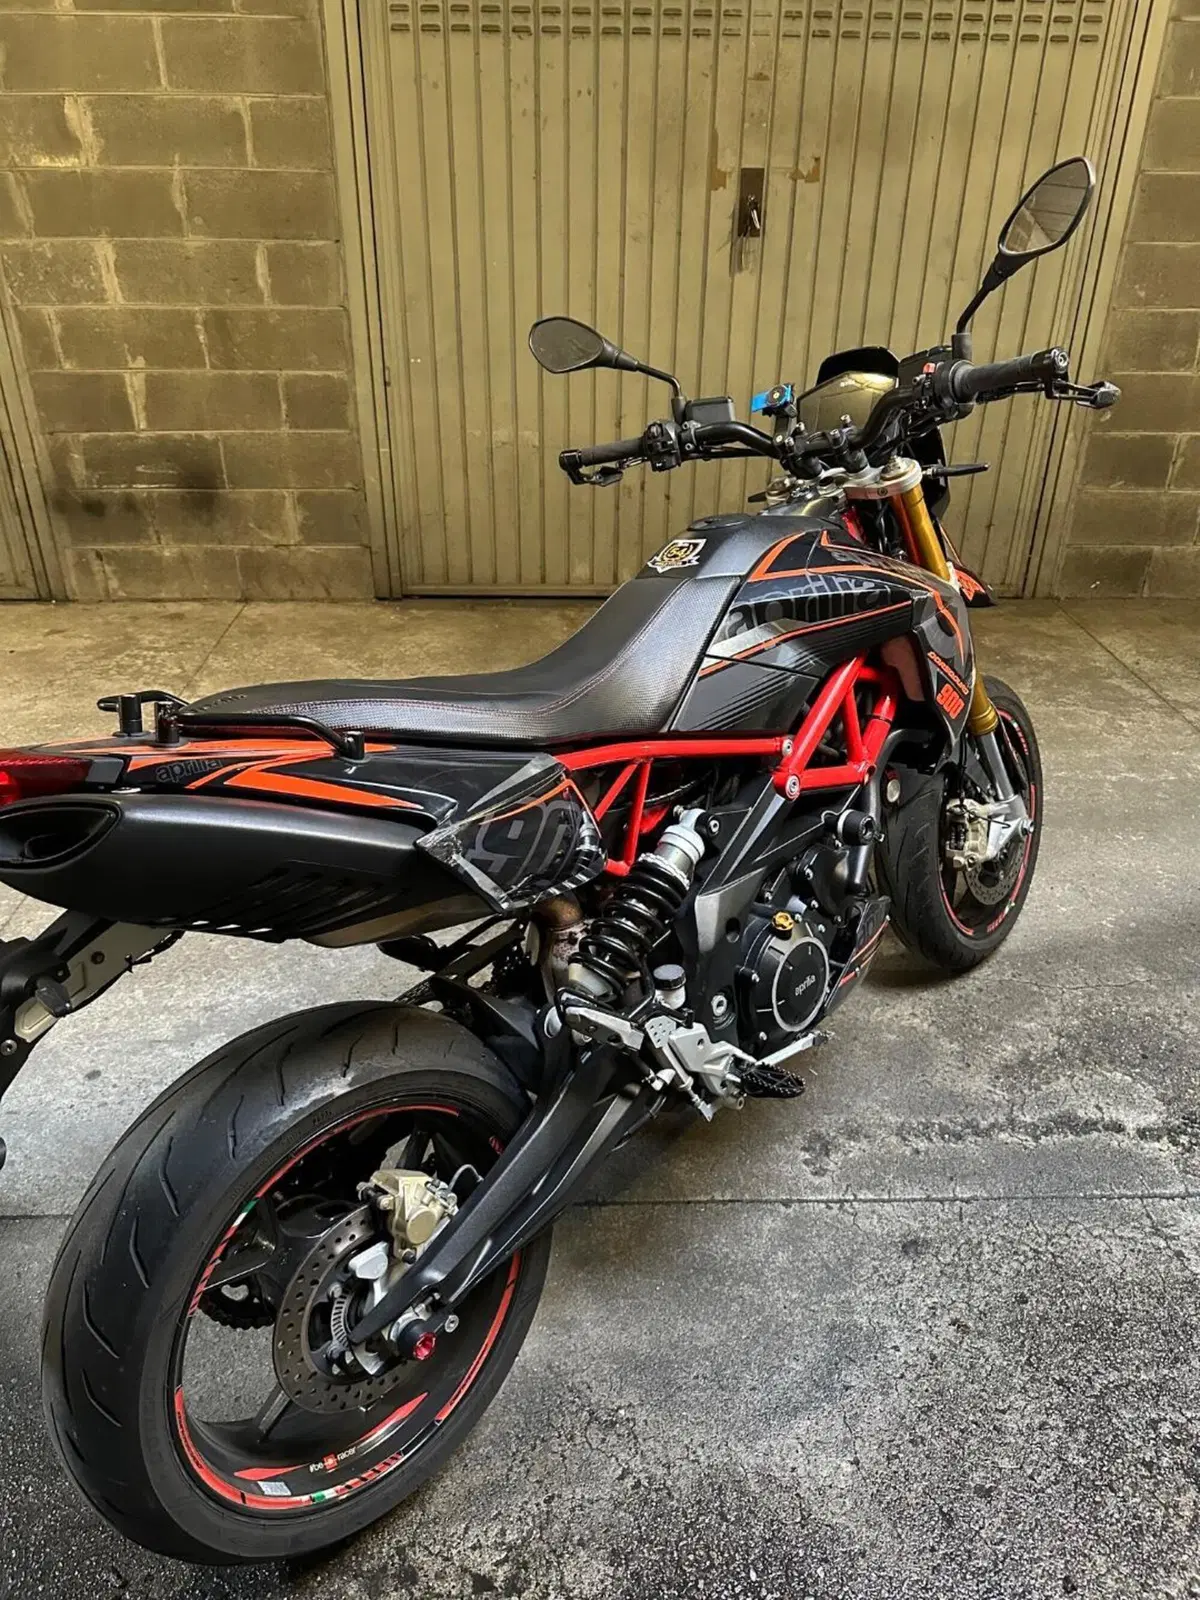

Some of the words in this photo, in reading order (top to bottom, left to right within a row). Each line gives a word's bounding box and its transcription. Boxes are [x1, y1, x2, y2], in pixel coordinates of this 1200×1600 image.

[936, 683, 965, 719] 900
[155, 758, 224, 784] aprilia
[793, 974, 817, 997] aprilia
[336, 1446, 356, 1461] racer
